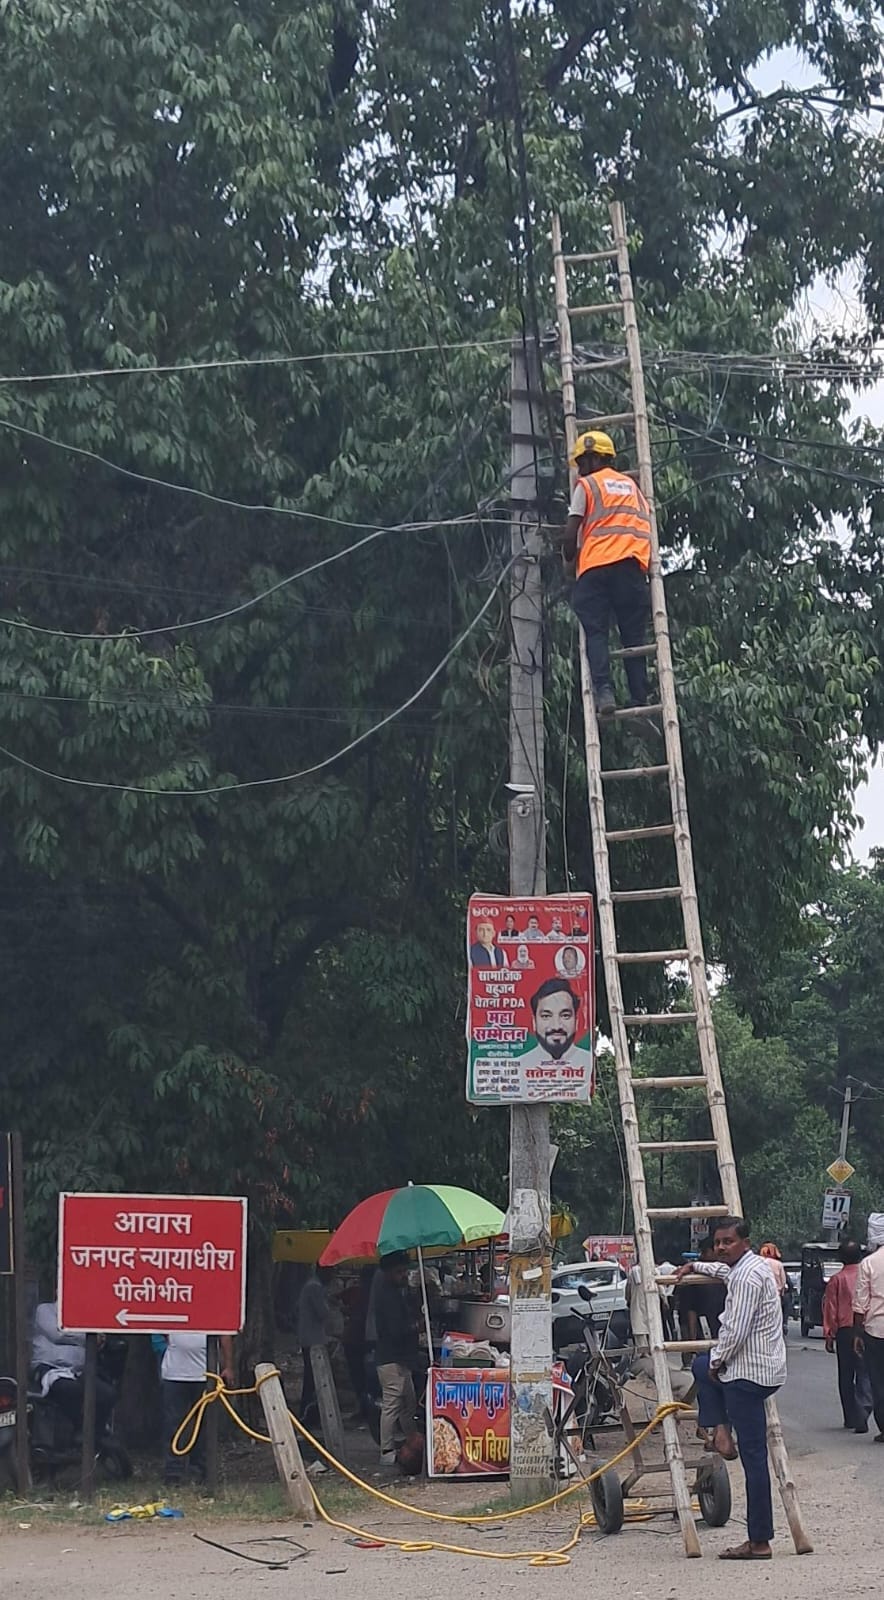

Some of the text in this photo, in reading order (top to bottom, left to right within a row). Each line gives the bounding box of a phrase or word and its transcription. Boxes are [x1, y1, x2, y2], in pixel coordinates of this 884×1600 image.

[478, 968, 522, 981] सामाजिक
[486, 983, 515, 997] बहुजन
[475, 995, 525, 1008] चेतना PDA
[488, 1011, 514, 1025] महा
[474, 1025, 528, 1042] सम्मेलन
[525, 1066, 585, 1078] सतेन्द्र मौर्य
[831, 1197, 846, 1212] 17
[114, 1211, 193, 1234] आवास
[70, 1242, 235, 1271] जनपद न्यायाधीश
[113, 1277, 193, 1302] पीलीभीत
[465, 1428, 483, 1463] वेज
